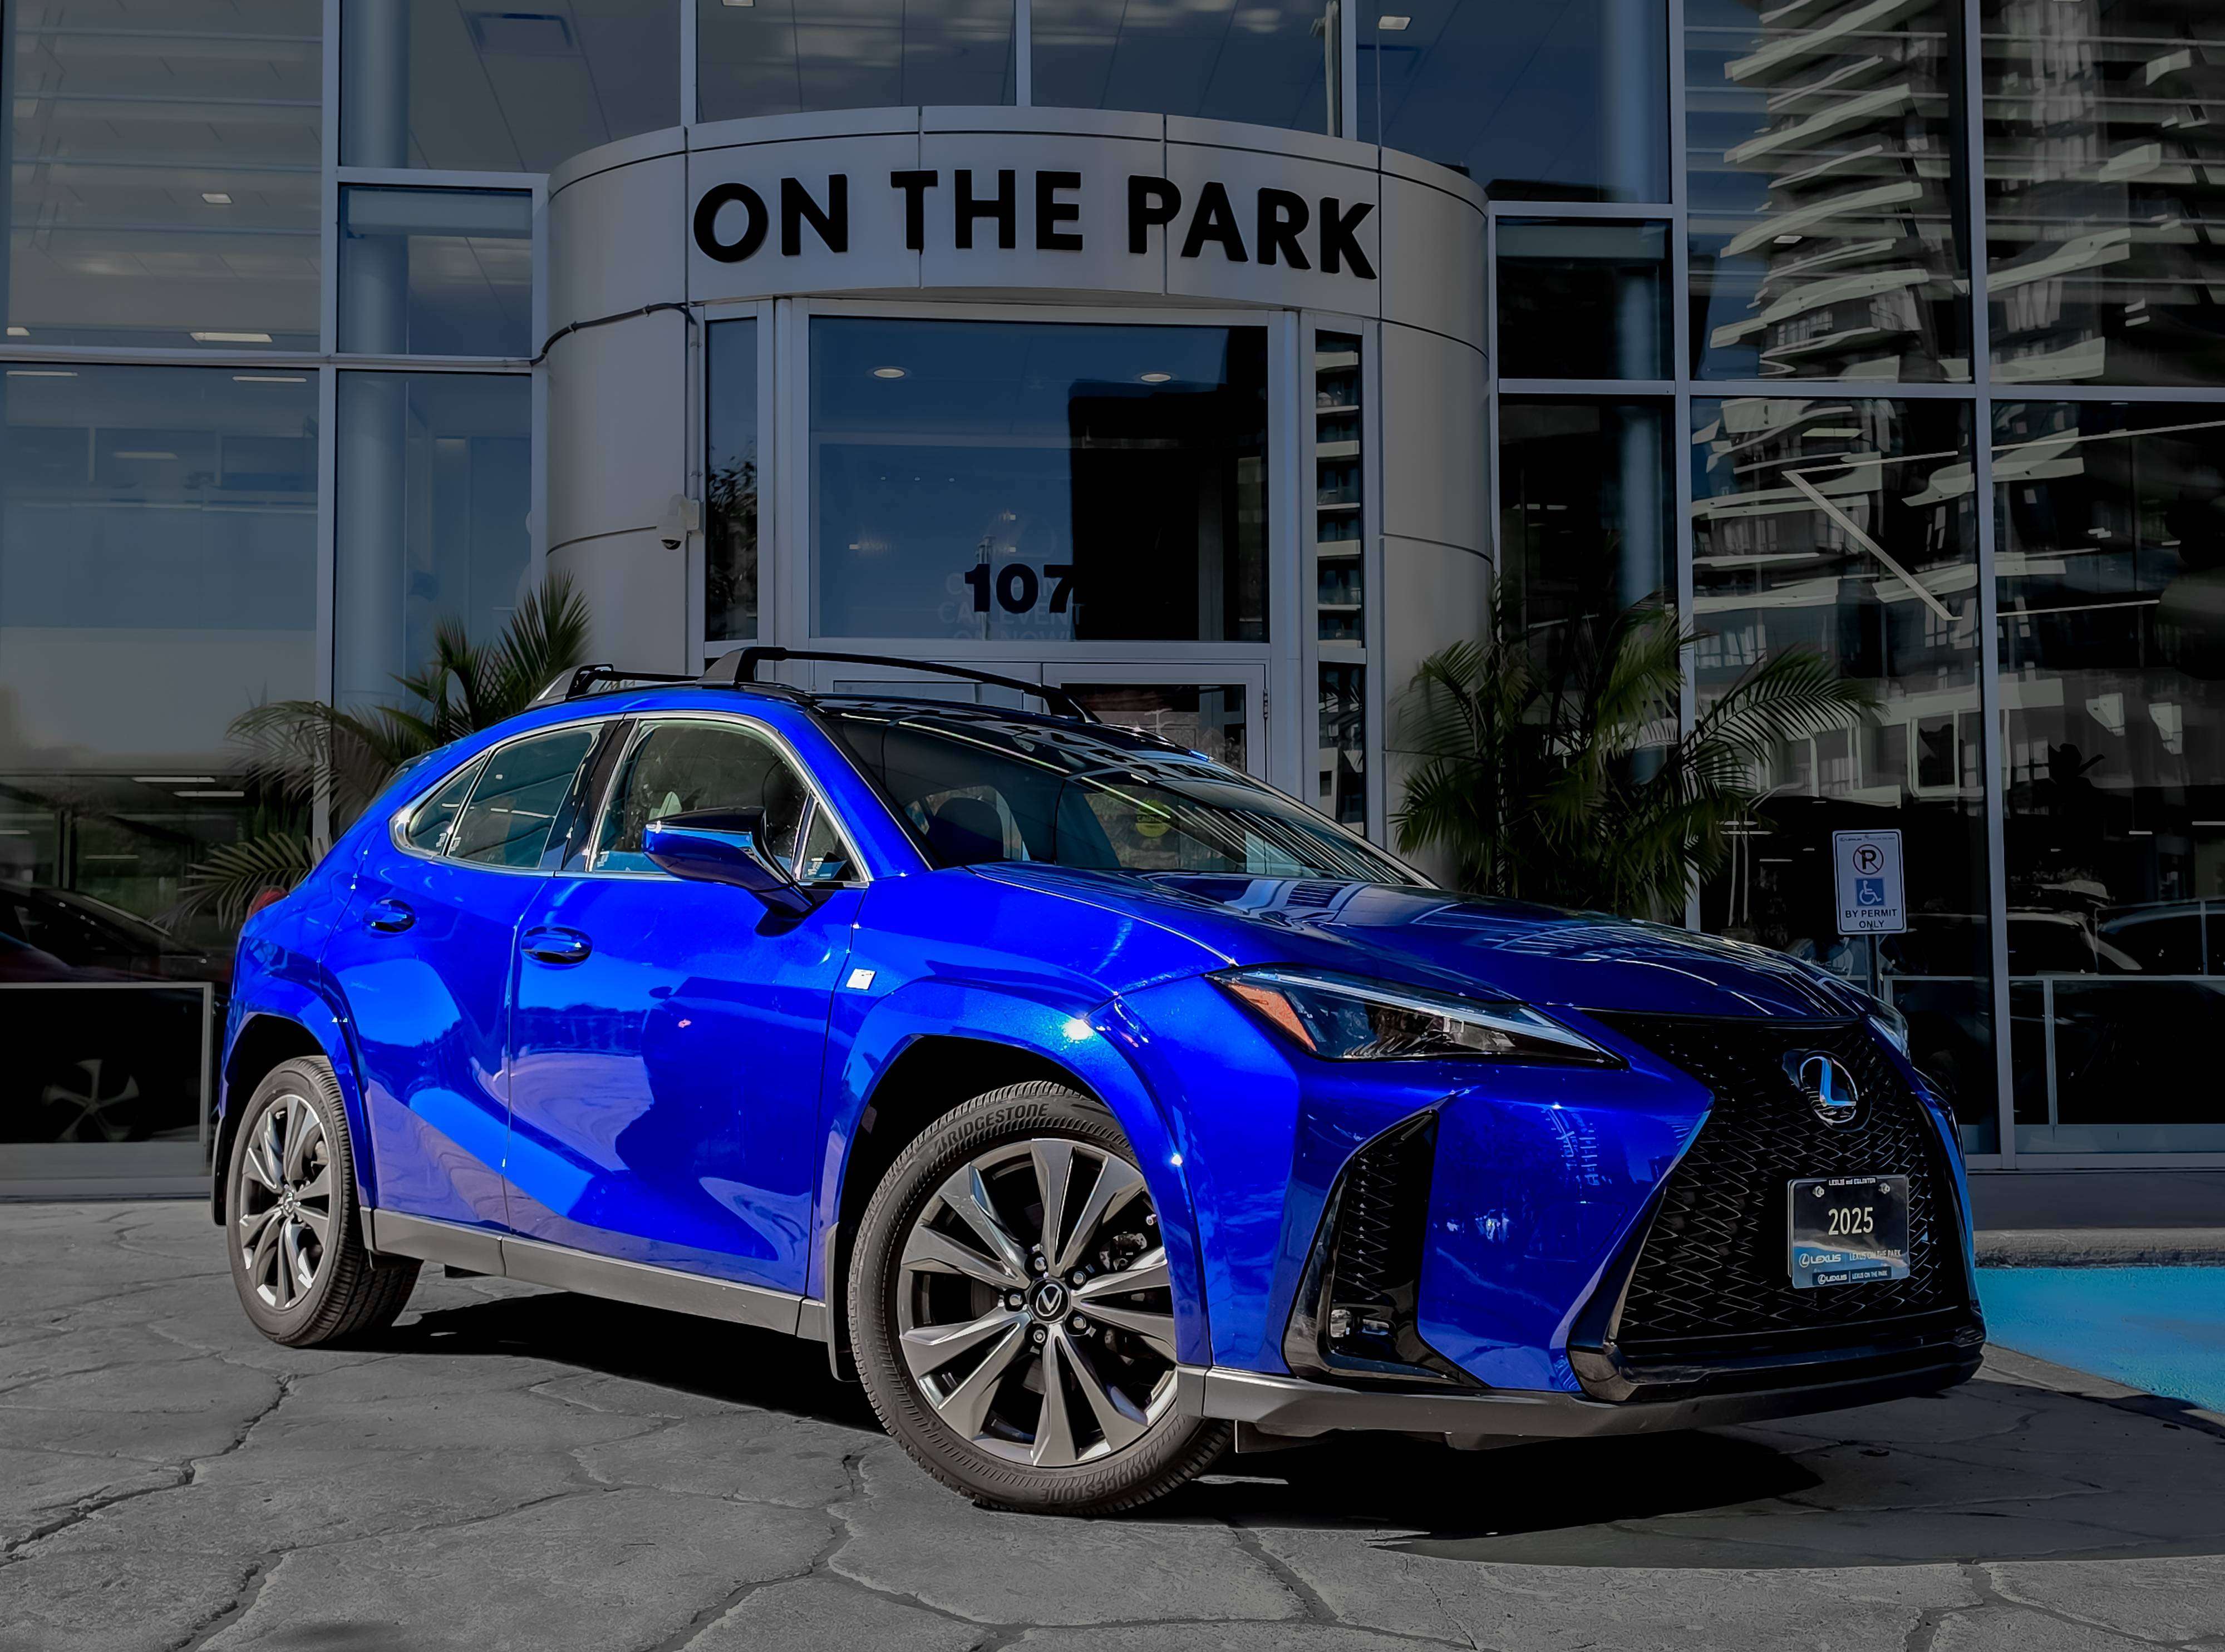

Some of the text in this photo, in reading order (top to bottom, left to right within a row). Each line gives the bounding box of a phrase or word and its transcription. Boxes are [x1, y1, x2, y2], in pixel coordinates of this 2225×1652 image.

[693, 169, 1377, 279] ON THE PARK
[964, 563, 1078, 613] 107
[1845, 909, 1897, 918] BY PERMIT
[935, 1103, 1050, 1155] BRIDGESTONE
[1828, 1206, 1874, 1236] 2025
[1810, 1254, 1842, 1264] LEXUS
[1849, 1252, 1866, 1261] LEXUS
[1887, 1249, 1902, 1258] PARK
